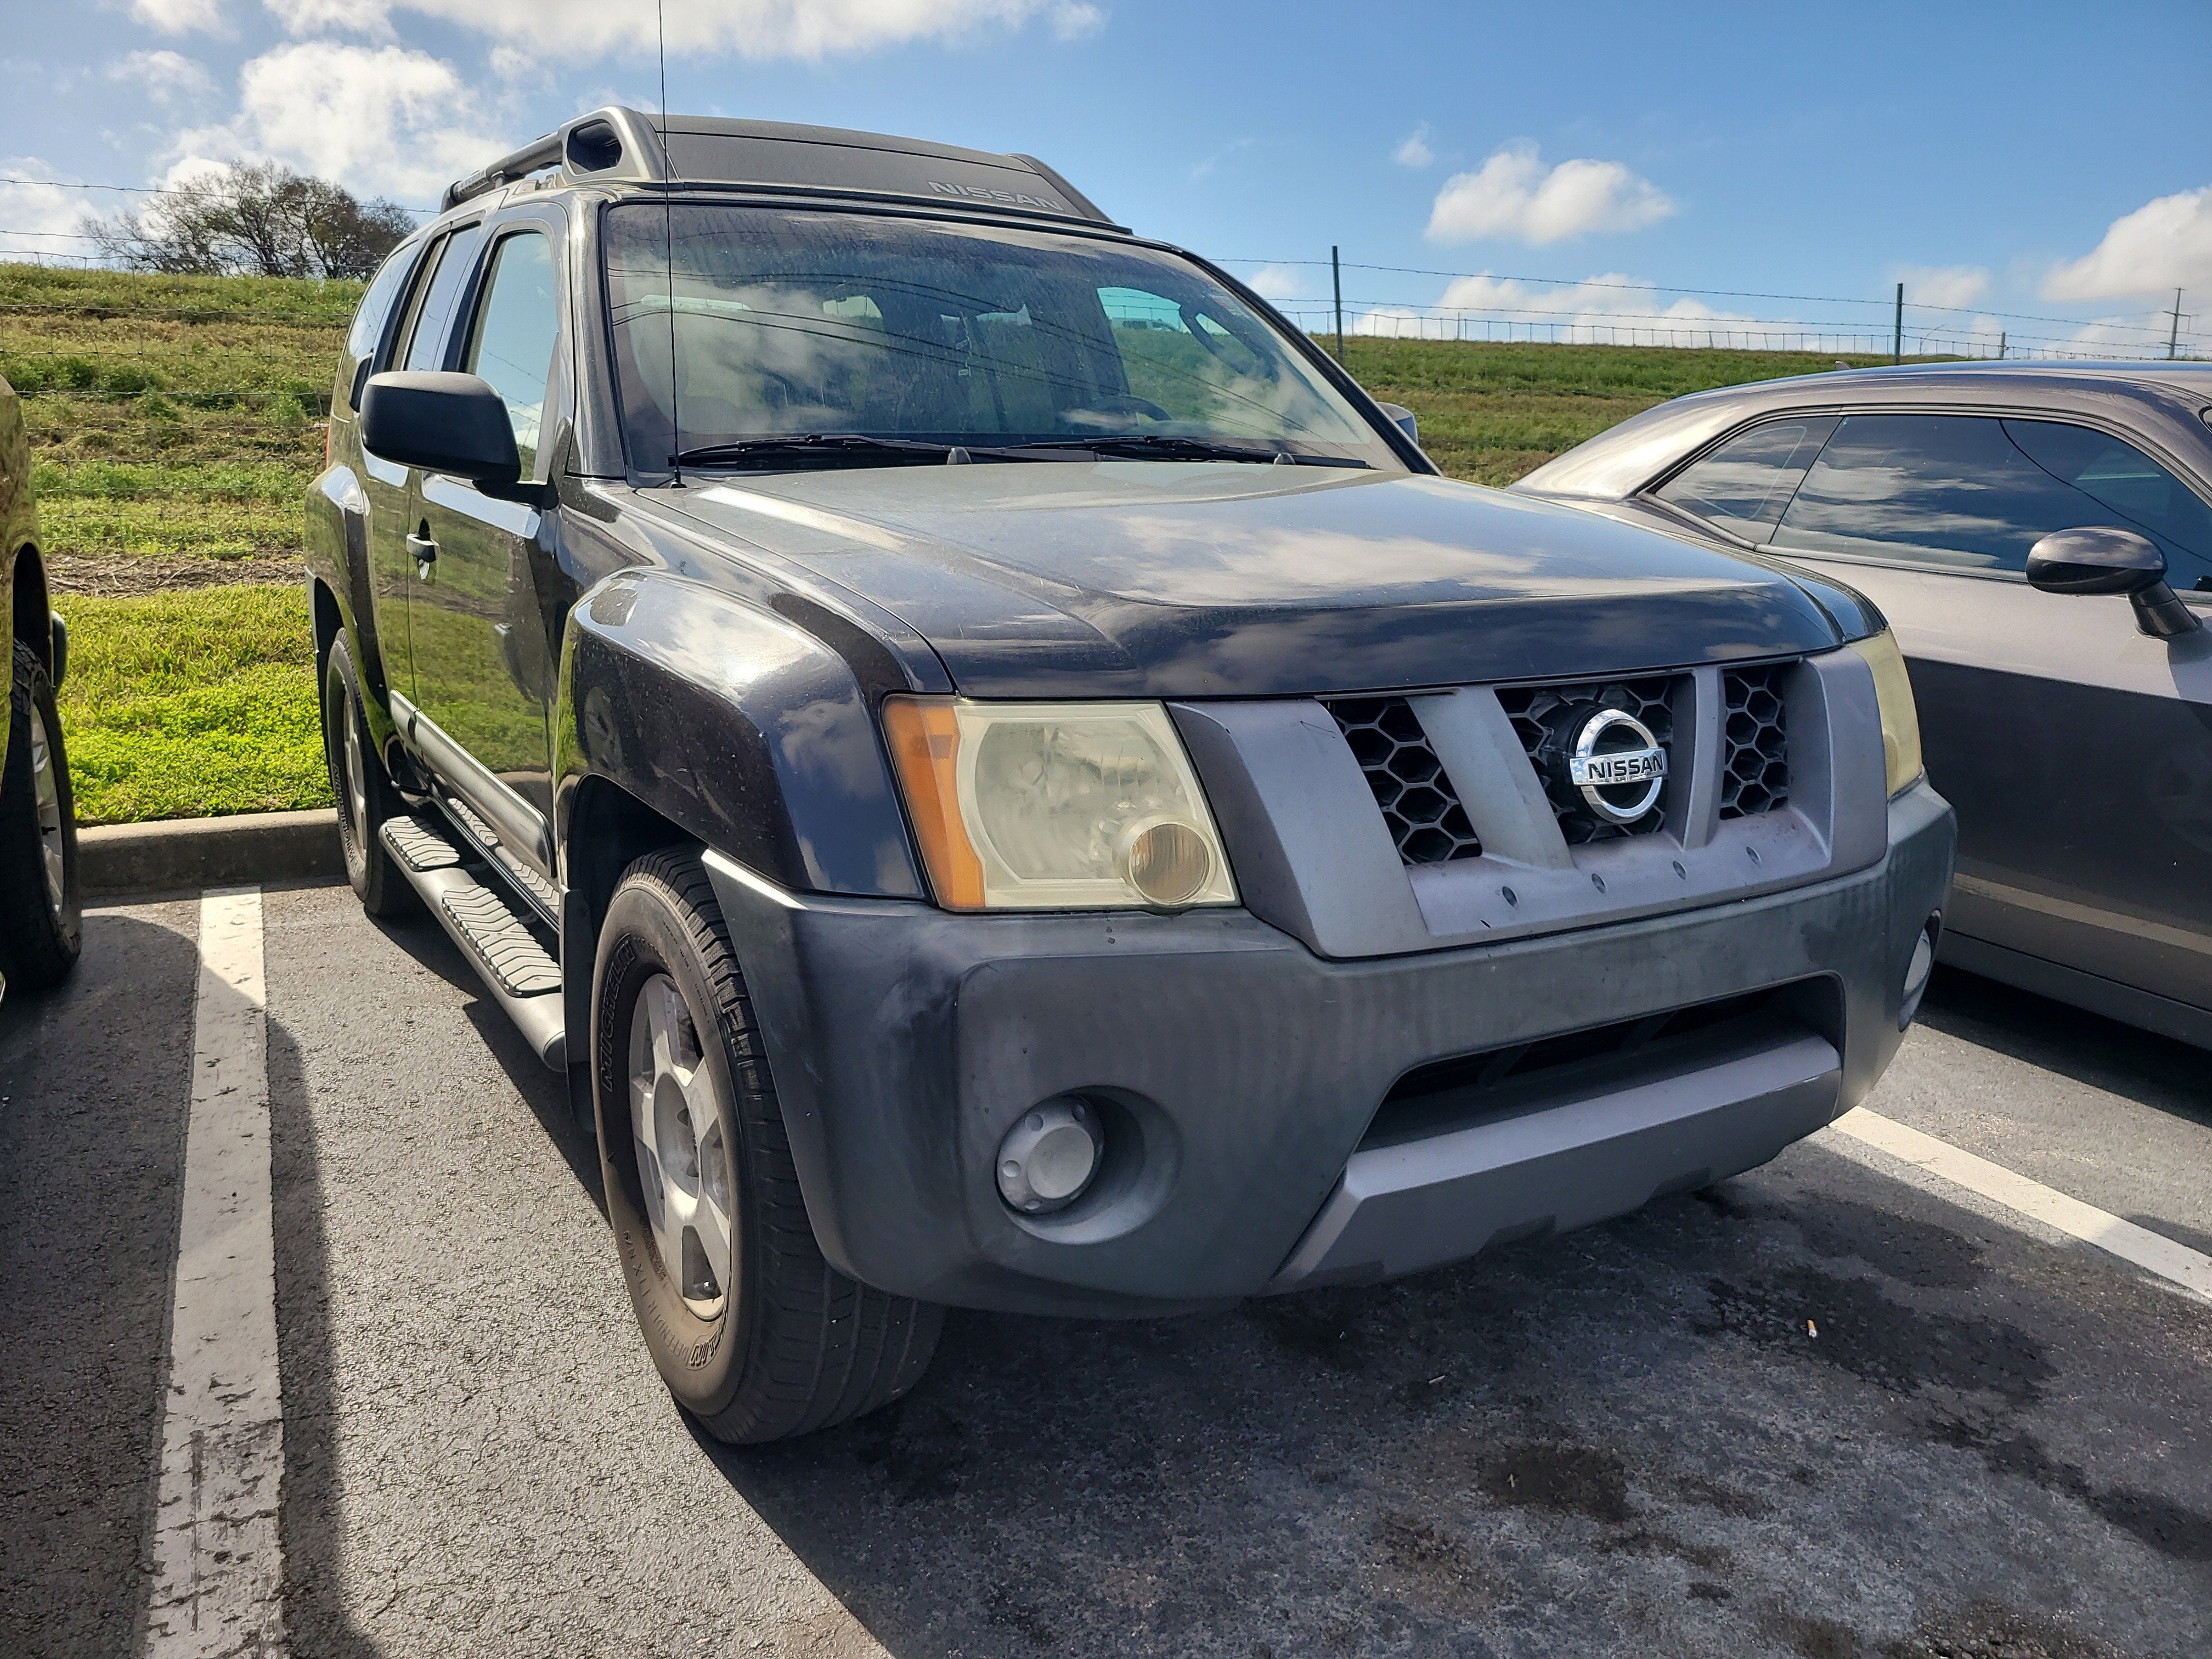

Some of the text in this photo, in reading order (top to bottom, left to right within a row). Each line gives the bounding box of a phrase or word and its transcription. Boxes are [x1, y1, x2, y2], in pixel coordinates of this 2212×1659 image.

[928, 182, 1064, 211] NISSAN
[1587, 754, 1663, 779] NISSAN
[600, 939, 636, 1093] MICHELIN
